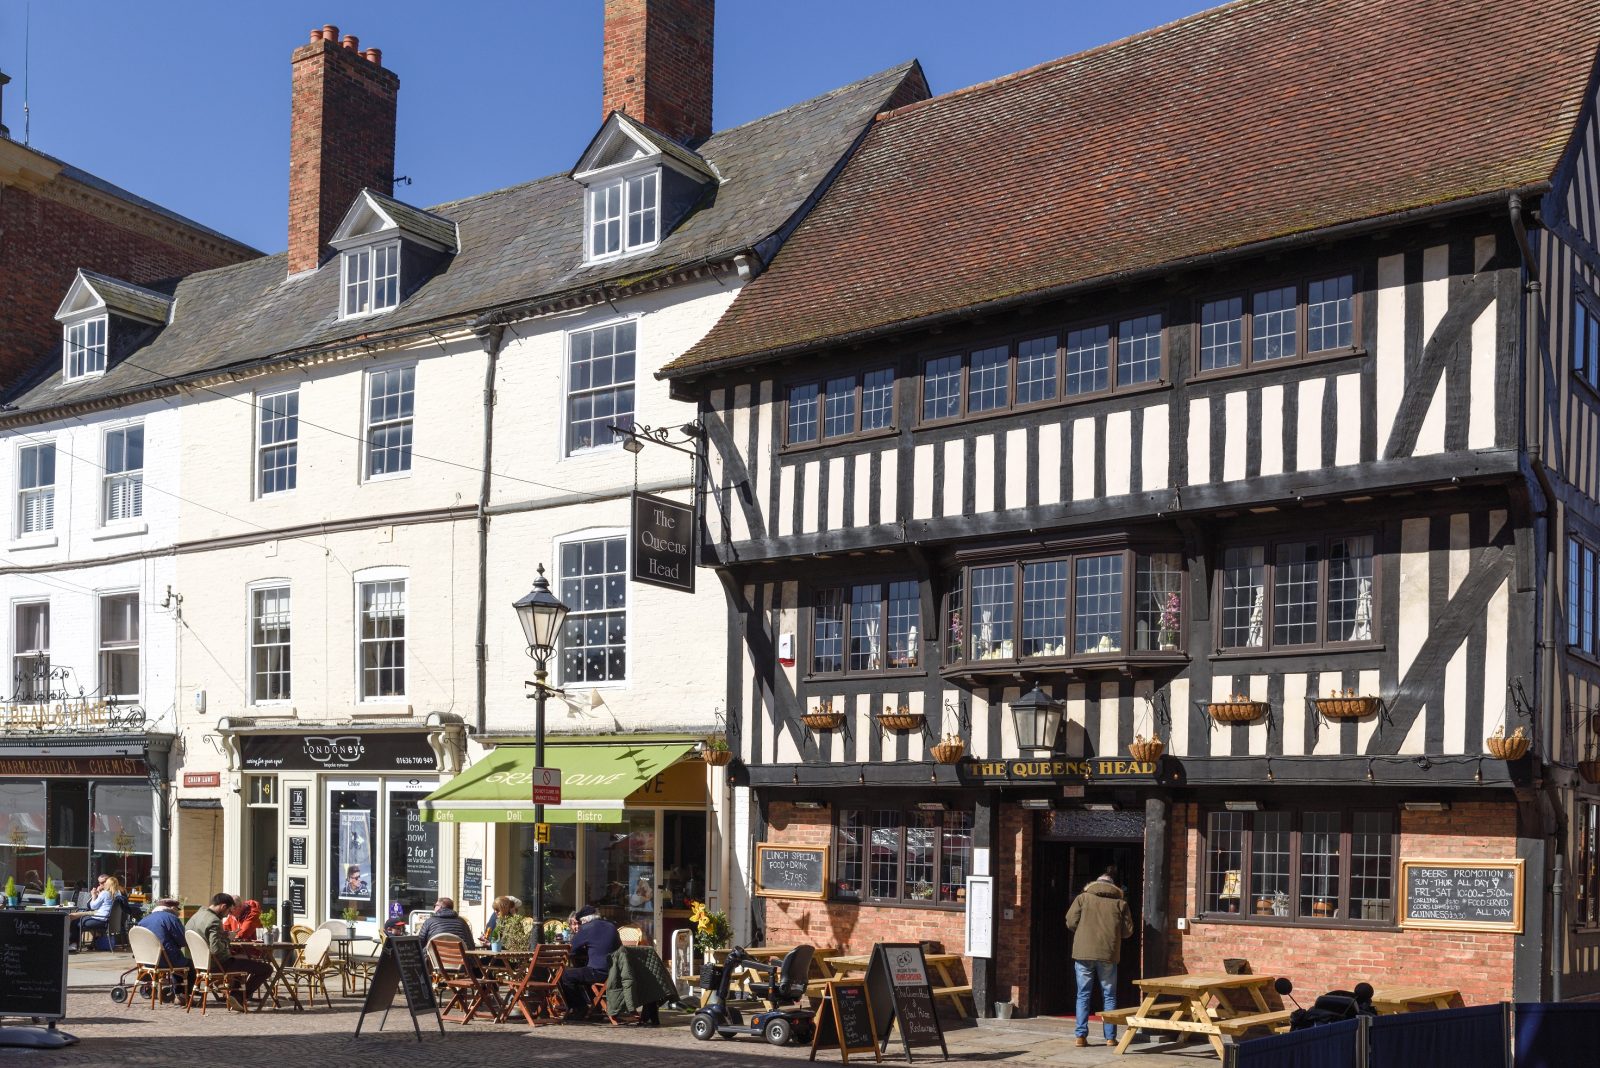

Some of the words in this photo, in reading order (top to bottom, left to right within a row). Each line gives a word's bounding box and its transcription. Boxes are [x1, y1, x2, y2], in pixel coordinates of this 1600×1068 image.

[653, 509, 675, 529] The
[641, 530, 687, 555] Queens
[649, 558, 680, 580] Head
[11, 703, 50, 727] BEAN
[55, 703, 64, 726] &
[68, 700, 109, 725] VINE
[0, 760, 80, 774] HARMACEUTICAL
[89, 759, 138, 774] CHEMIST
[396, 757, 412, 765] 01636
[412, 757, 423, 765] 700
[423, 757, 434, 765] 949
[971, 761, 1006, 776] THE
[1013, 761, 1092, 777] QUEENS
[1099, 761, 1157, 774] HEAD
[564, 772, 627, 786] OLIVE
[507, 810, 522, 821] Deli
[577, 810, 603, 821] Bistro
[407, 823, 425, 832] look
[407, 833, 427, 842] now!
[407, 846, 413, 857] 2
[414, 846, 428, 858] for
[430, 847, 434, 858] 1
[766, 851, 789, 860] LUNCH
[791, 852, 819, 862] SPECIAL
[1421, 869, 1448, 878] BEERS
[1453, 869, 1504, 878] PROMOTION
[1457, 879, 1471, 887] ALL
[1474, 879, 1489, 887] DAY
[1467, 898, 1486, 906] FOOD
[1486, 898, 1509, 907] SERVED
[1411, 910, 1448, 919] GUINNESS
[1475, 908, 1492, 916] ALL
[1493, 908, 1512, 917] DAY
